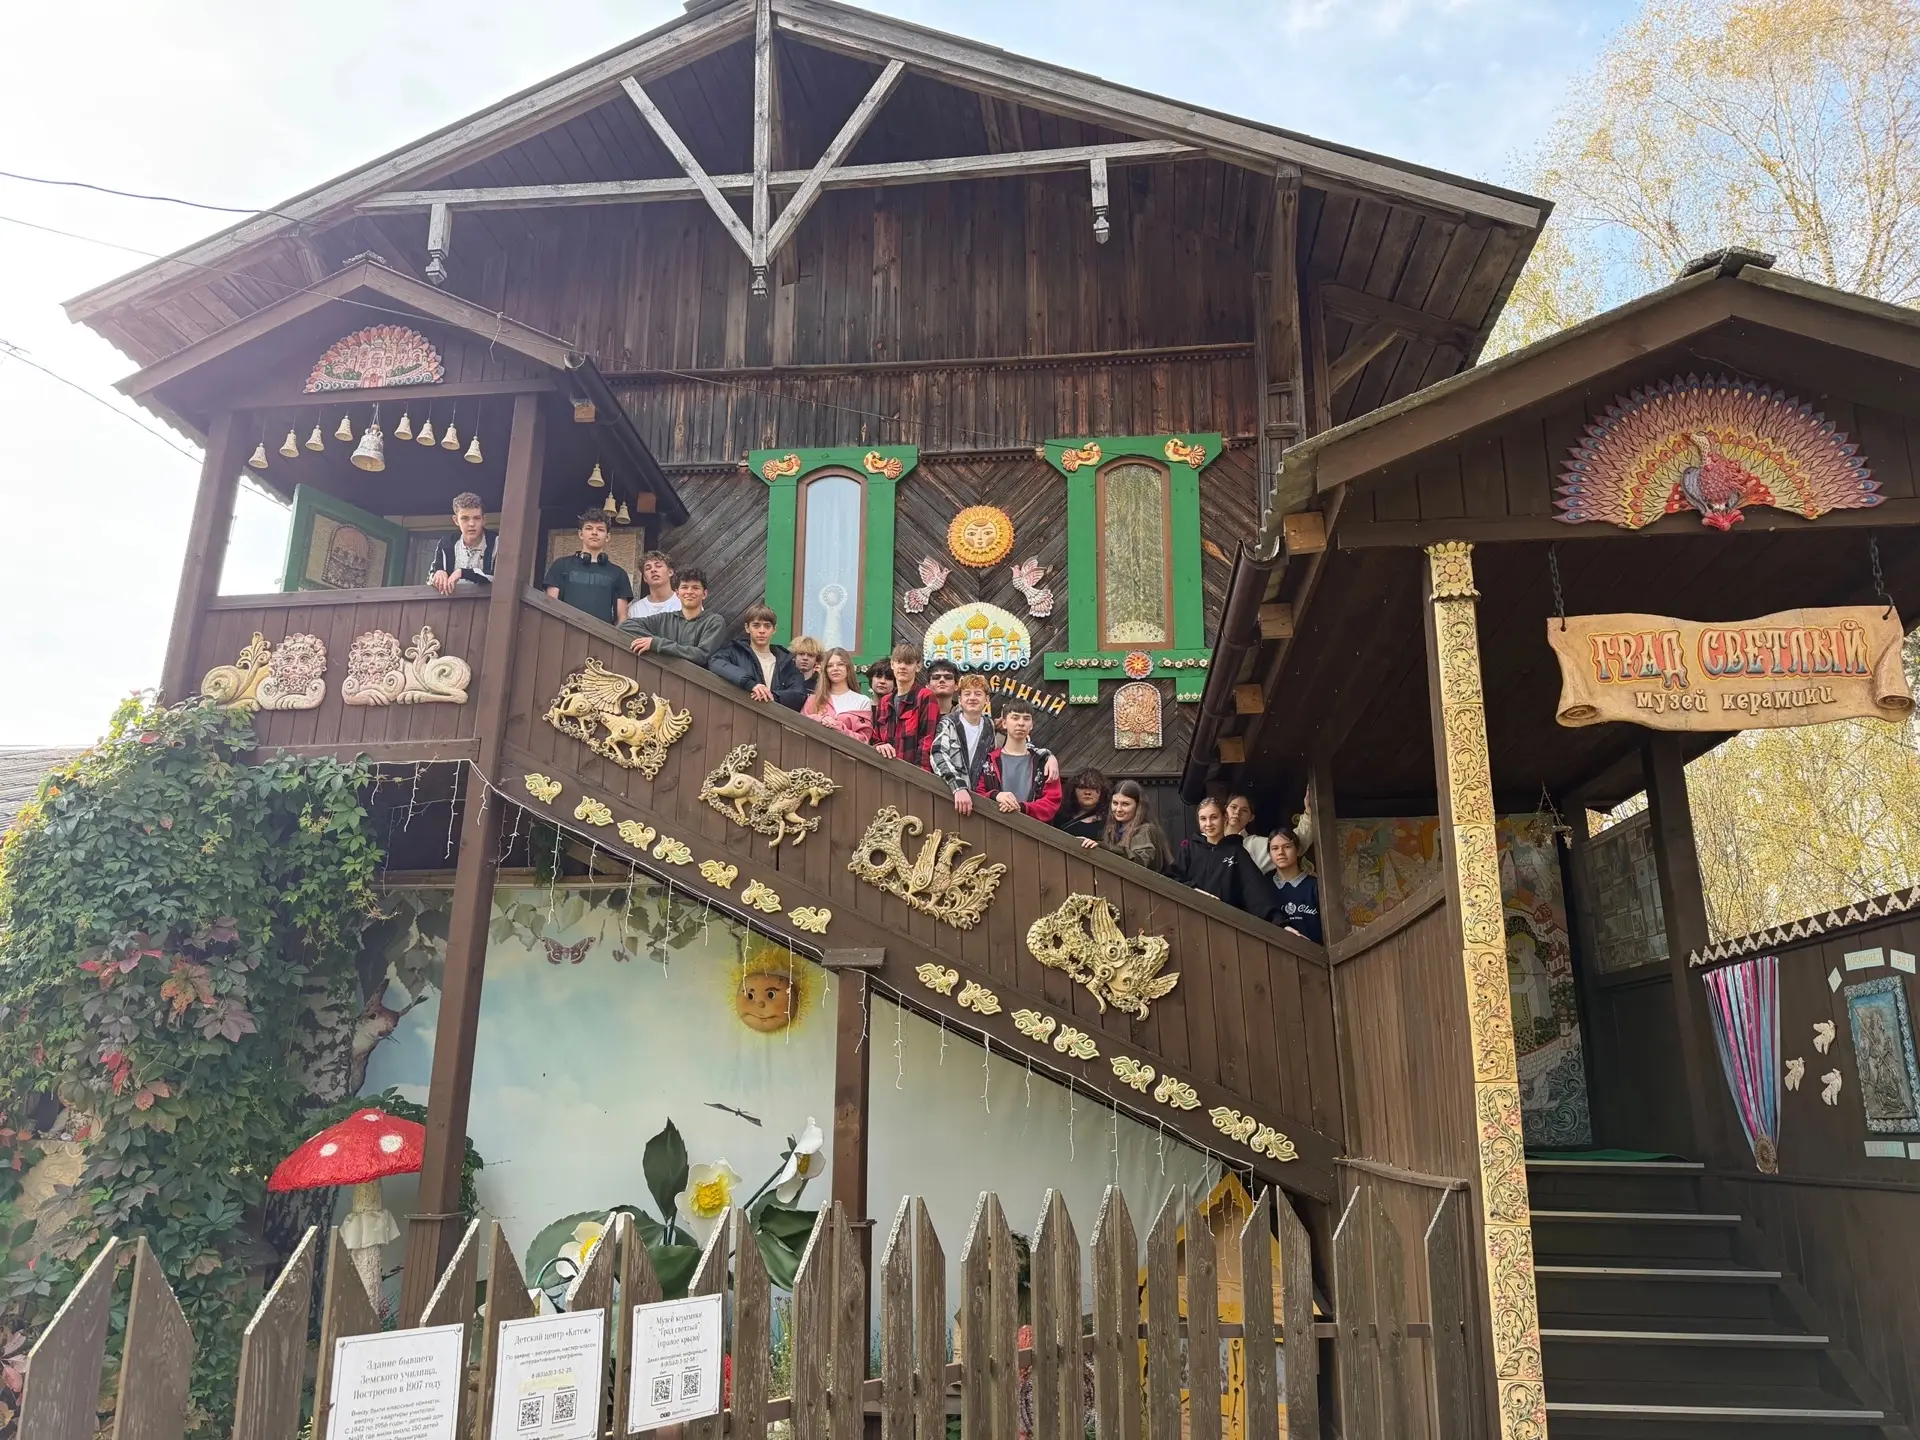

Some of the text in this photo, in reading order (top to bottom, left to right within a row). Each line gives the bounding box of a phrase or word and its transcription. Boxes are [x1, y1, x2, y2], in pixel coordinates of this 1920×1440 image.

[1591, 620, 1869, 690] ГРАД СВЕТЛЫЙ
[1721, 686, 1837, 716] керамики
[514, 1327, 591, 1346] Детский центр «Китеж»
[366, 1355, 434, 1371] Здание бывшего
[360, 1374, 399, 1385] Земского
[353, 1386, 398, 1400] Построено
[406, 1380, 423, 1392] 1907
[424, 1380, 442, 1391] году
[351, 1426, 365, 1434] 1942
[432, 1413, 444, 1421] дом
[411, 1424, 422, 1432] 150
[422, 1422, 439, 1430] детей
